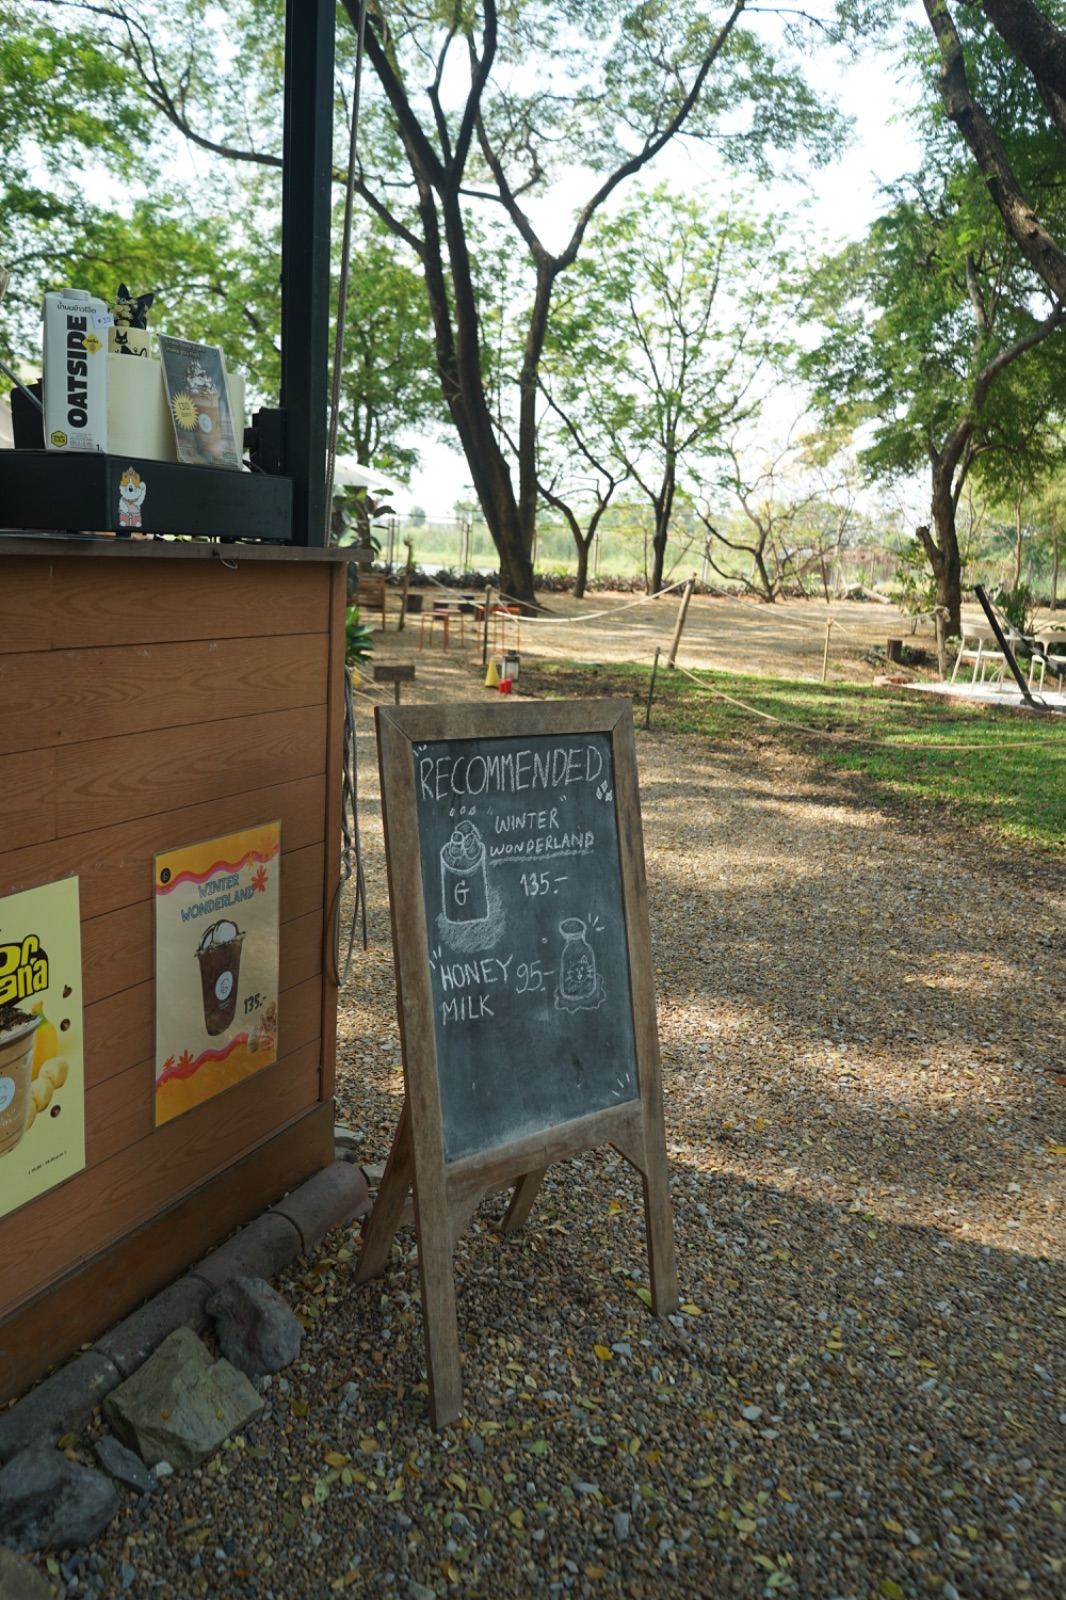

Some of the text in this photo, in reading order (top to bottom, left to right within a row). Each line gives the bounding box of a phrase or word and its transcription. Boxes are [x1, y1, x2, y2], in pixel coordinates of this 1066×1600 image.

[66, 314, 87, 429] OATSIDE
[420, 745, 604, 801] RECOMMENDED
[495, 807, 560, 834] WINTER
[489, 830, 595, 858] WONDERLAND
[197, 873, 240, 899] WINTER
[454, 880, 470, 906] G
[180, 885, 255, 922] WONDERLAND
[440, 954, 513, 991] HONEY
[441, 994, 495, 1026] MILK
